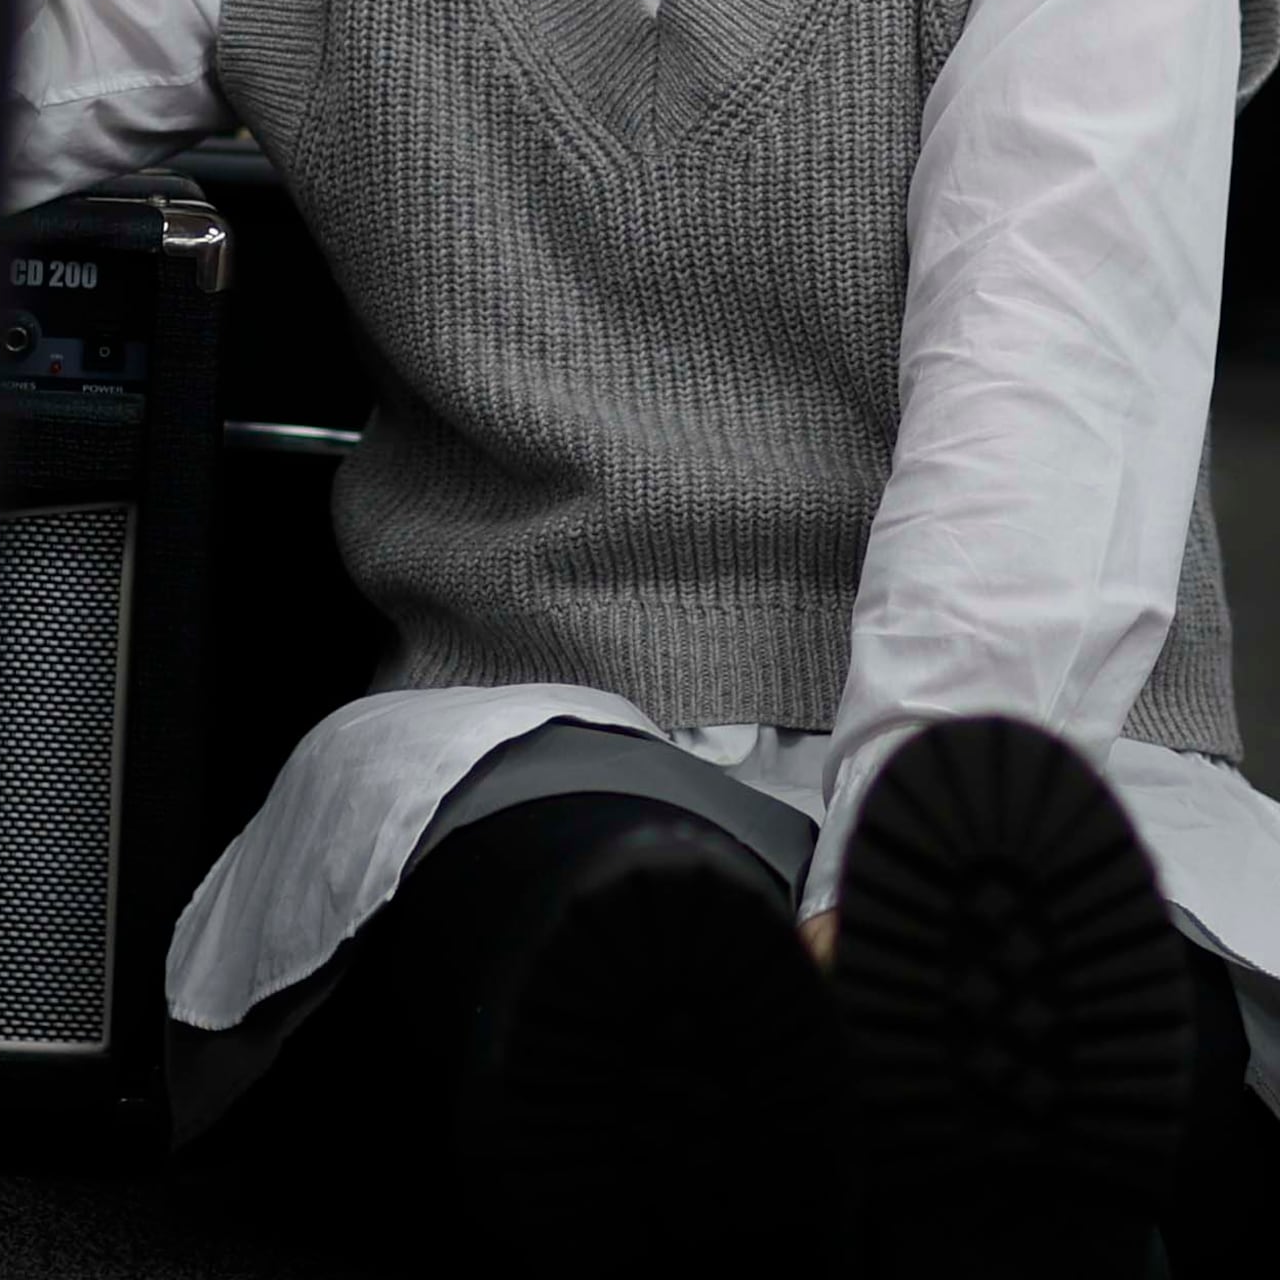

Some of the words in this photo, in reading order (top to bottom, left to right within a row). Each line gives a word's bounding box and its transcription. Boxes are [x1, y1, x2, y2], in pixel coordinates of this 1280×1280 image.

[10, 258, 44, 287] CD
[48, 259, 99, 290] 200
[82, 383, 125, 394] POWER
